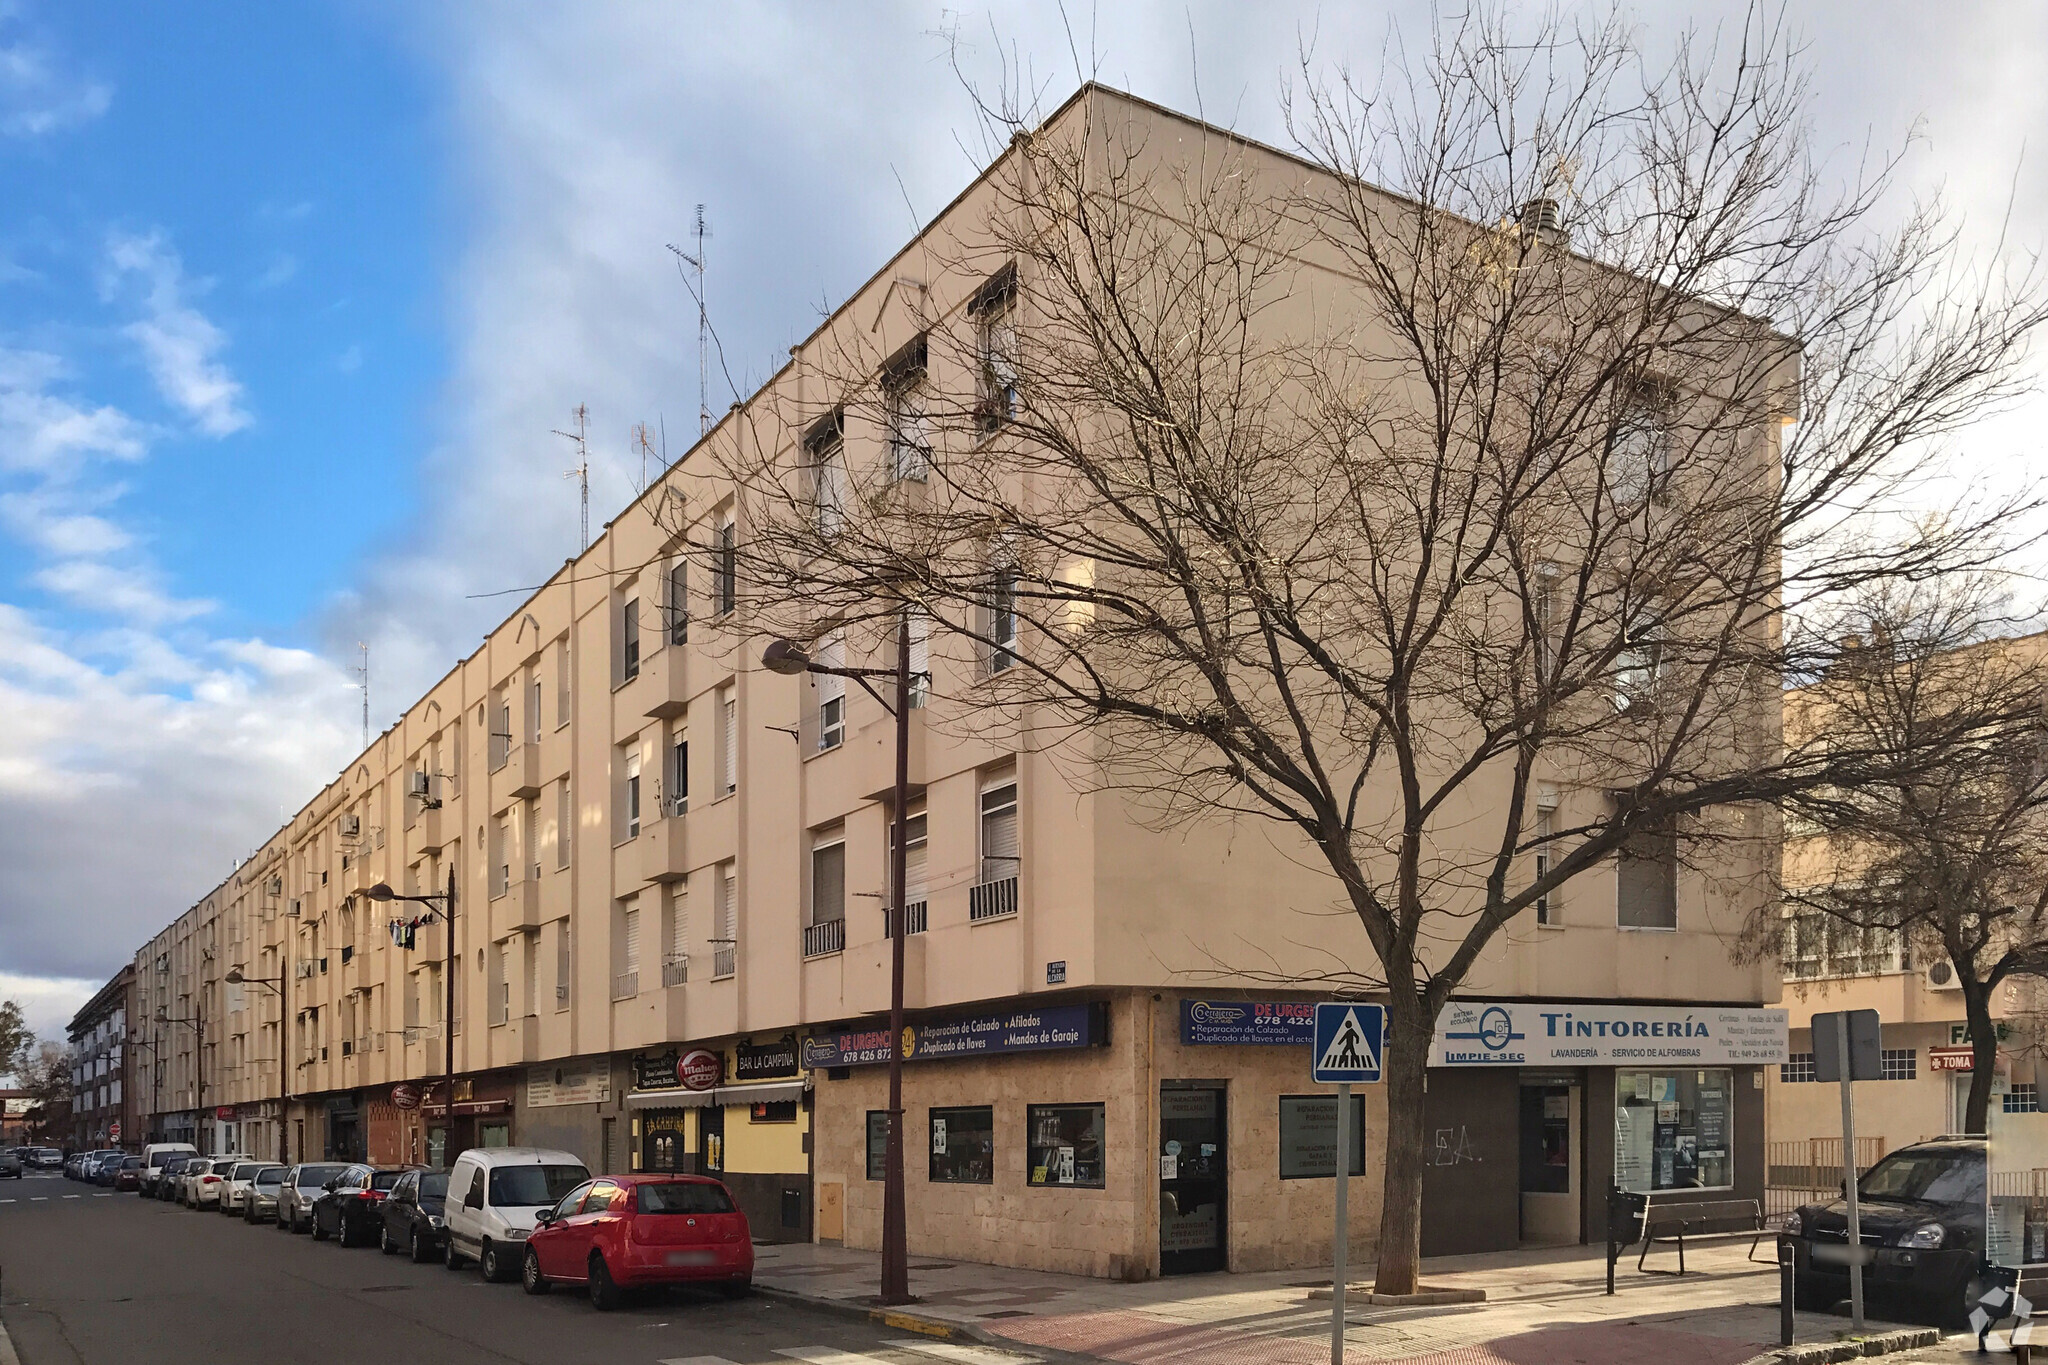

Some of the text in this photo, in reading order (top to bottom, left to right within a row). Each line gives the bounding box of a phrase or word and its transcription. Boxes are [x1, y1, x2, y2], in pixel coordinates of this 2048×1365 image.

[1048, 973, 1065, 982] ALCARRIA
[1254, 1003, 1272, 1017] DE
[1453, 1010, 1473, 1019] SISTEMA
[1010, 1014, 1041, 1028] Afilados
[1254, 1016, 1314, 1025] 678 426
[924, 1018, 1000, 1039] Reparación de Calzado
[1197, 1024, 1289, 1035] Reparación de Calzado
[840, 1030, 892, 1052] DE URGENCI
[1008, 1029, 1079, 1046] Mandos de Garaje
[1197, 1034, 1313, 1045] Duplicado de llaves en el acto
[923, 1037, 986, 1055] Duplicado de llaves
[1551, 1047, 1701, 1058] LAVANDERÍA SERVICIO DE ALFOMBRAS
[739, 1051, 795, 1070] BAR LA CAMPIÑA
[843, 1048, 892, 1063] 678 426 872
[1446, 1051, 1525, 1063] LIMPIE-SEC
[1943, 1057, 1971, 1068] TOMA
[684, 1061, 718, 1075] Mahou
